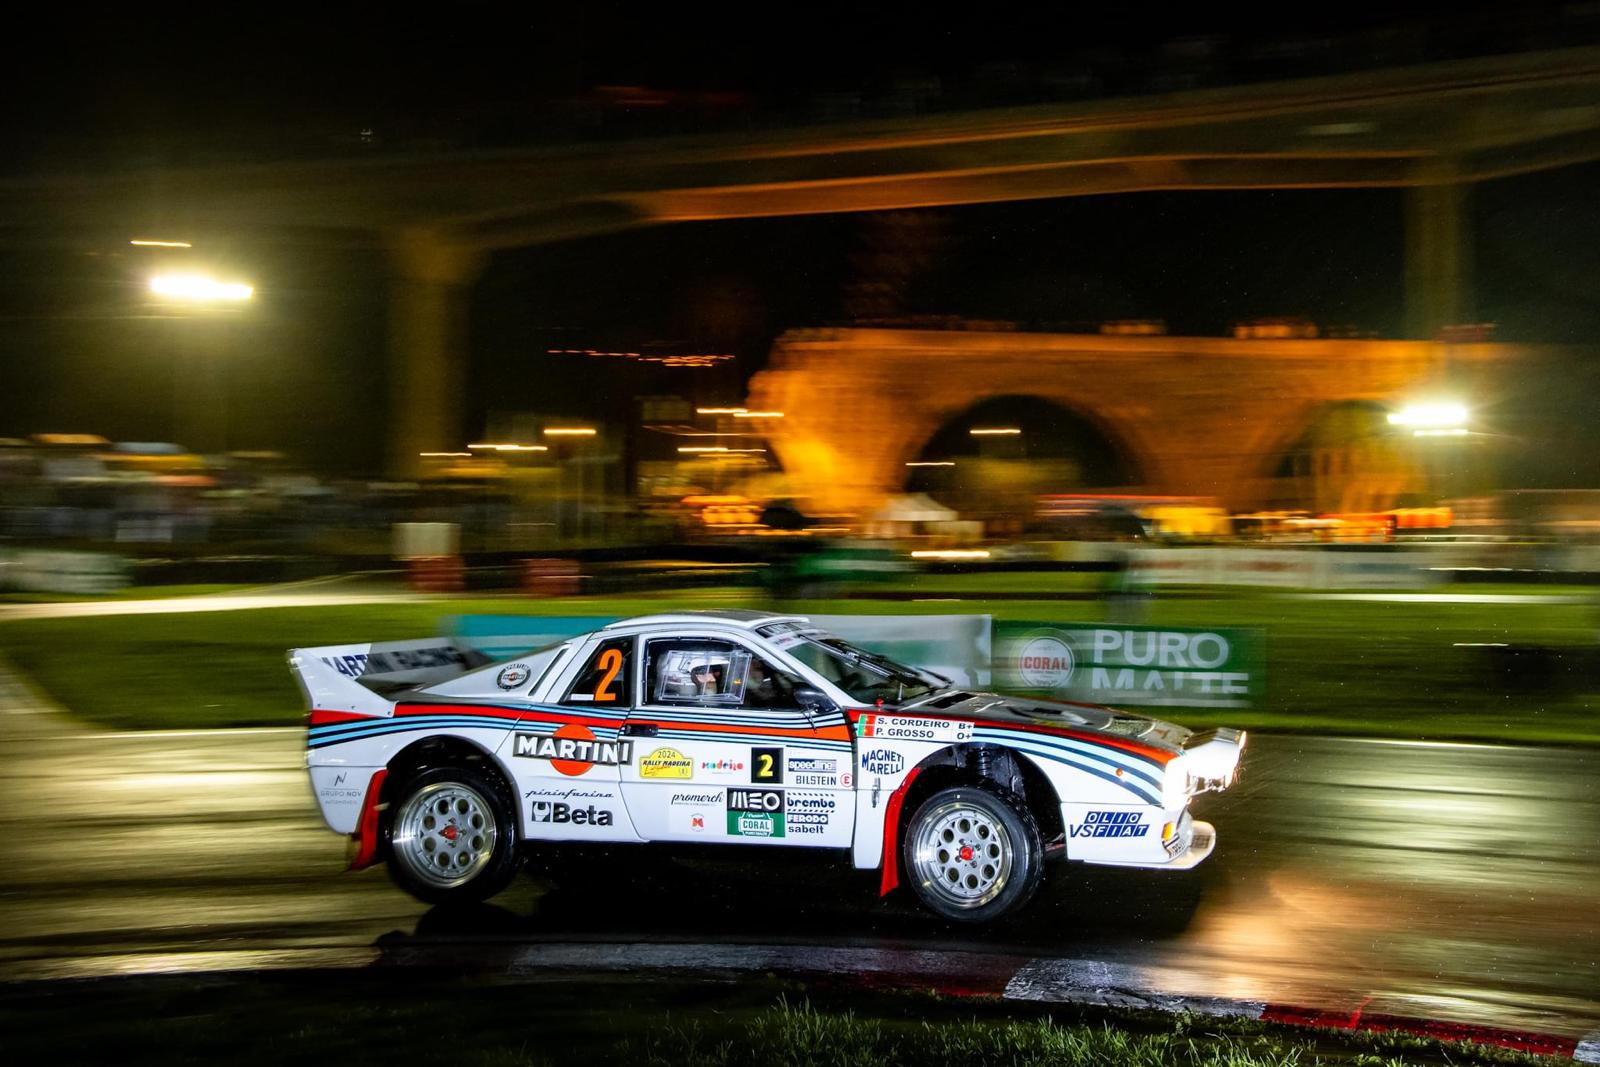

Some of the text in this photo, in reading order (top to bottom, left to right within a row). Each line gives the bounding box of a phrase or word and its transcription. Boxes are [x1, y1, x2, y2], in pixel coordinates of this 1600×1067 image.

[1093, 629, 1229, 669] PURO
[1024, 656, 1069, 671] CORAL
[595, 649, 623, 701] 2
[877, 717, 973, 730] S. CORDEIRO B+
[875, 727, 972, 740] P. GROSSO O+
[518, 736, 629, 763] MARTINI
[657, 751, 676, 759] 2024
[861, 749, 904, 766] MAGNETI
[757, 754, 774, 777] 2
[861, 758, 904, 775] MARELLI
[796, 775, 836, 786] BILSTEIN
[671, 791, 724, 805] promerch
[731, 791, 781, 811] MEO
[787, 797, 836, 808] brembo
[553, 802, 613, 826] Beta
[787, 814, 829, 824] FERODO
[1087, 812, 1140, 823] OLIO
[743, 820, 770, 830] CORAL
[788, 825, 824, 834] sabelt
